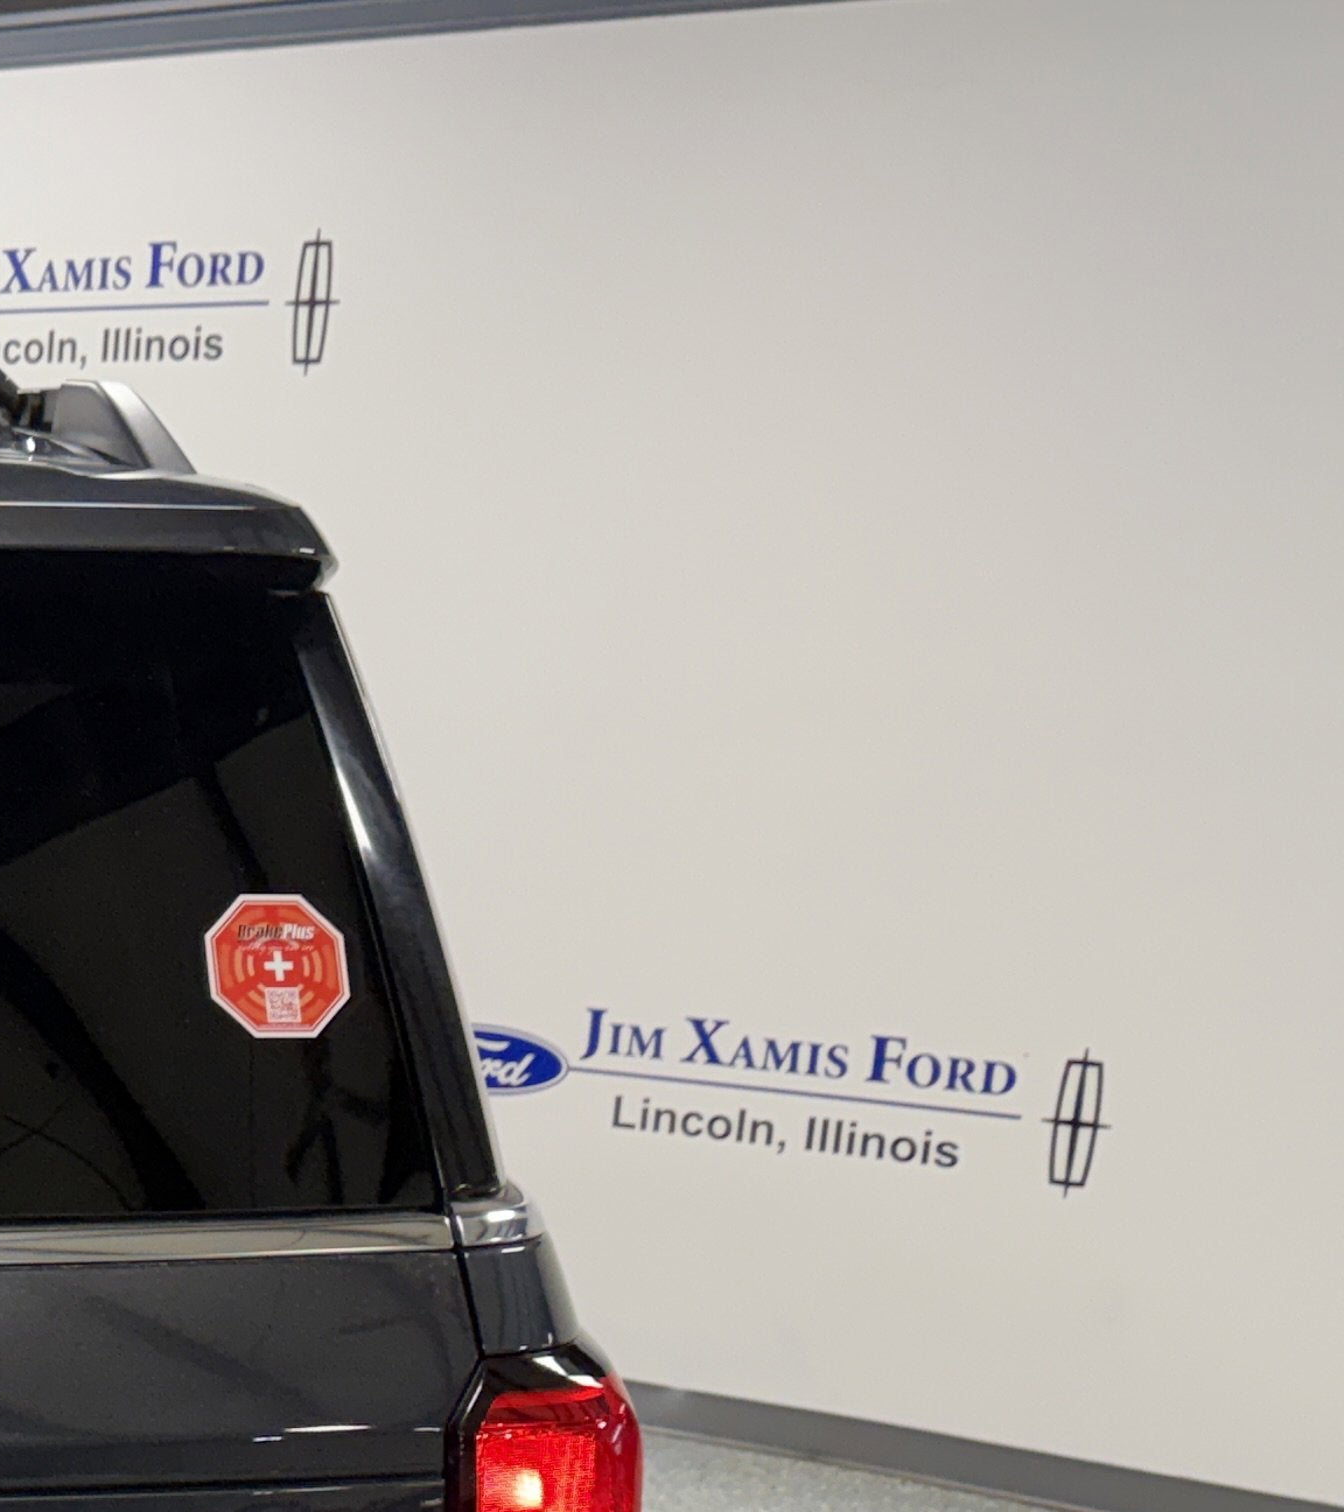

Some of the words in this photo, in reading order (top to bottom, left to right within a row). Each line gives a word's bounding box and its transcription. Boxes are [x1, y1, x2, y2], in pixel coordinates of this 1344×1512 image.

[144, 241, 265, 288] FORD
[101, 326, 224, 363] Illinois
[580, 1008, 667, 1061] JIM
[682, 1017, 848, 1080] XAMIS
[864, 1035, 1018, 1097] FORD
[611, 1094, 787, 1153] Lincoln,
[804, 1115, 960, 1170] Illinois
